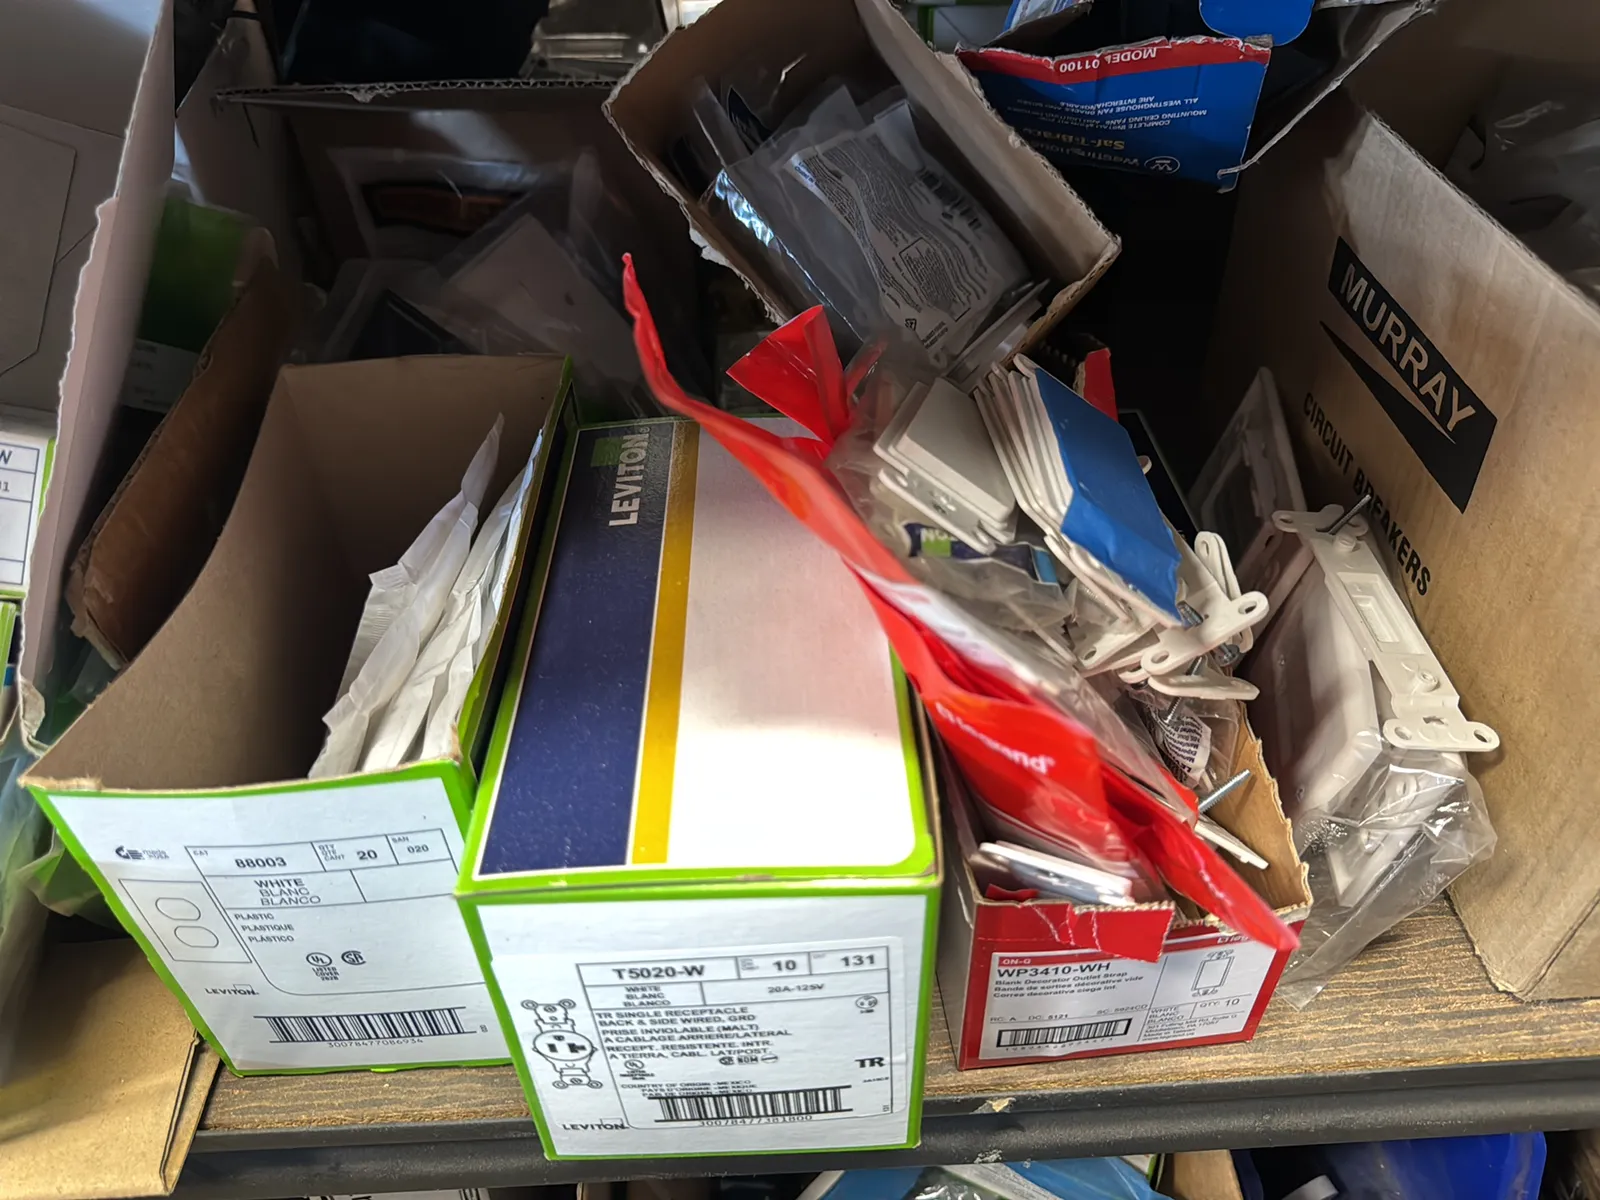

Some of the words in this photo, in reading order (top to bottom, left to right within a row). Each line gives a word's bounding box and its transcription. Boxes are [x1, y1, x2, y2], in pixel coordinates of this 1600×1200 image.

[1059, 59, 1100, 73] 01100
[1115, 98, 1183, 113] WESTINGHOUSE
[1138, 95, 1155, 104] ARE
[1183, 97, 1199, 105] ALL
[1097, 107, 1115, 116] FAN
[1158, 108, 1208, 120] MOUNTING
[1127, 113, 1159, 123] CEILING
[1128, 119, 1171, 130] COMPLETE
[1340, 263, 1476, 432] MURRAY
[609, 431, 650, 526] LEVITON
[1302, 392, 1354, 476] CIRCUIT
[1353, 468, 1431, 596] BREAKERS
[406, 844, 429, 854] 020
[356, 850, 378, 861] 20
[234, 856, 287, 869] 88003
[253, 877, 305, 889] WHITE
[259, 887, 310, 897] BLANC
[260, 895, 321, 907] BLANCO
[234, 913, 274, 921] PLASTIC
[241, 924, 294, 932] PLASTIQUE
[772, 959, 797, 972] 10
[840, 955, 876, 967] 131
[612, 964, 705, 980] T5020-W
[997, 961, 1111, 978] WP3410-WH
[1024, 976, 1071, 985] Decorator
[1072, 973, 1102, 982] Outlet
[1103, 971, 1128, 980] Strap
[204, 987, 255, 996] LEVITON
[624, 985, 661, 993] WHITE
[767, 983, 825, 994] 20A-125V
[1027, 987, 1076, 997] decorativa
[625, 992, 665, 1000] BLANC
[622, 999, 671, 1008] BLANCO
[1224, 998, 1241, 1007] 10
[595, 1012, 612, 1020] TR
[615, 1009, 663, 1019] SINGLE
[664, 1006, 748, 1018] RECEPTACLE
[599, 1019, 635, 1027] BACK
[637, 1018, 647, 1026] &
[649, 1017, 678, 1026] SIDE
[728, 1014, 756, 1022] GRD
[601, 1027, 639, 1036] PRISE
[640, 1025, 714, 1035] INVIOLABLE
[717, 1023, 760, 1033] (MALT)
[618, 1034, 675, 1043] CABLAGE
[676, 1029, 793, 1042] ARRIERE/LATERAL
[606, 1044, 658, 1053] RECEPT.
[742, 1039, 774, 1048] INTR.
[609, 1052, 620, 1060] A
[855, 1056, 887, 1068] TR
[562, 1122, 627, 1132] LEVITON
